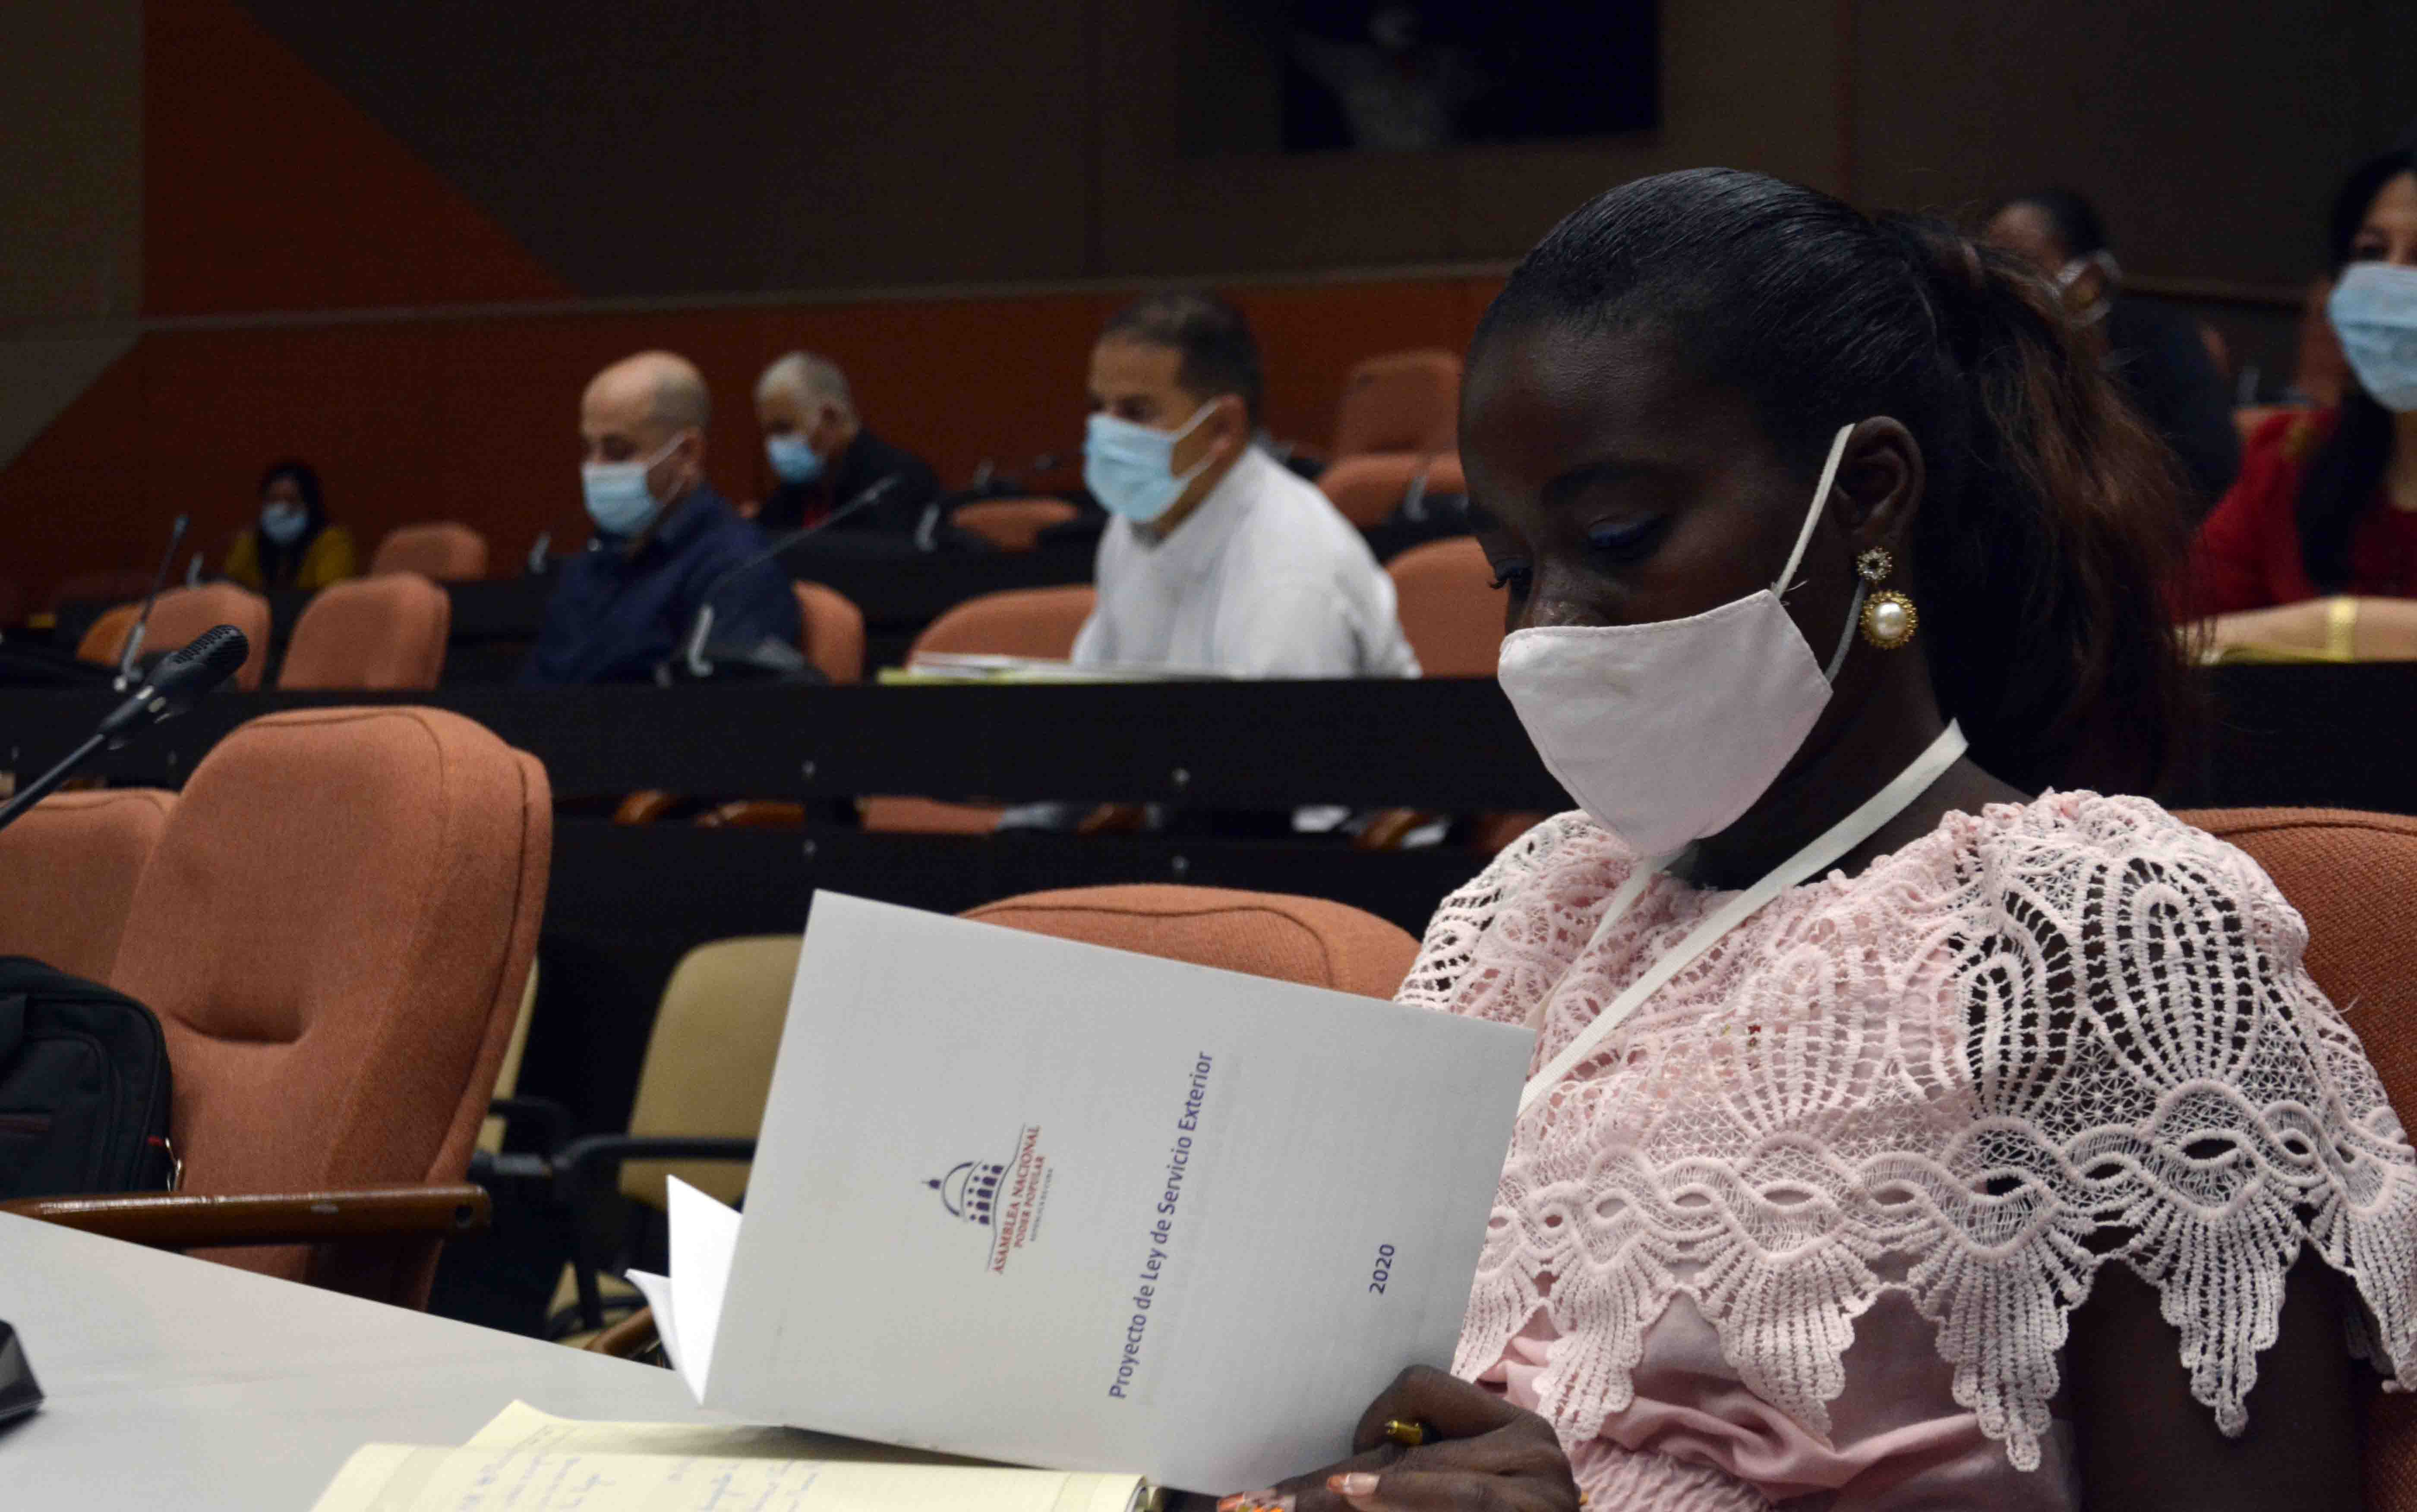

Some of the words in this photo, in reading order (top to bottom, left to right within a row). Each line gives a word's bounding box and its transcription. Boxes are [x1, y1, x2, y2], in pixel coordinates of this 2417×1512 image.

[1178, 1051, 1212, 1131] Exterior
[993, 1202, 1019, 1273] ASAMBLEA
[1012, 1125, 1040, 1196] NACIONAL
[1015, 1211, 1031, 1247] PODER
[1025, 1156, 1045, 1207] POPULAR
[1158, 1136, 1192, 1214] Servicio
[1140, 1248, 1167, 1280] Ley
[1150, 1219, 1171, 1244] de
[1369, 1244, 1395, 1294] 2020
[1133, 1285, 1155, 1310] de
[1108, 1314, 1146, 1399] Proyecto
